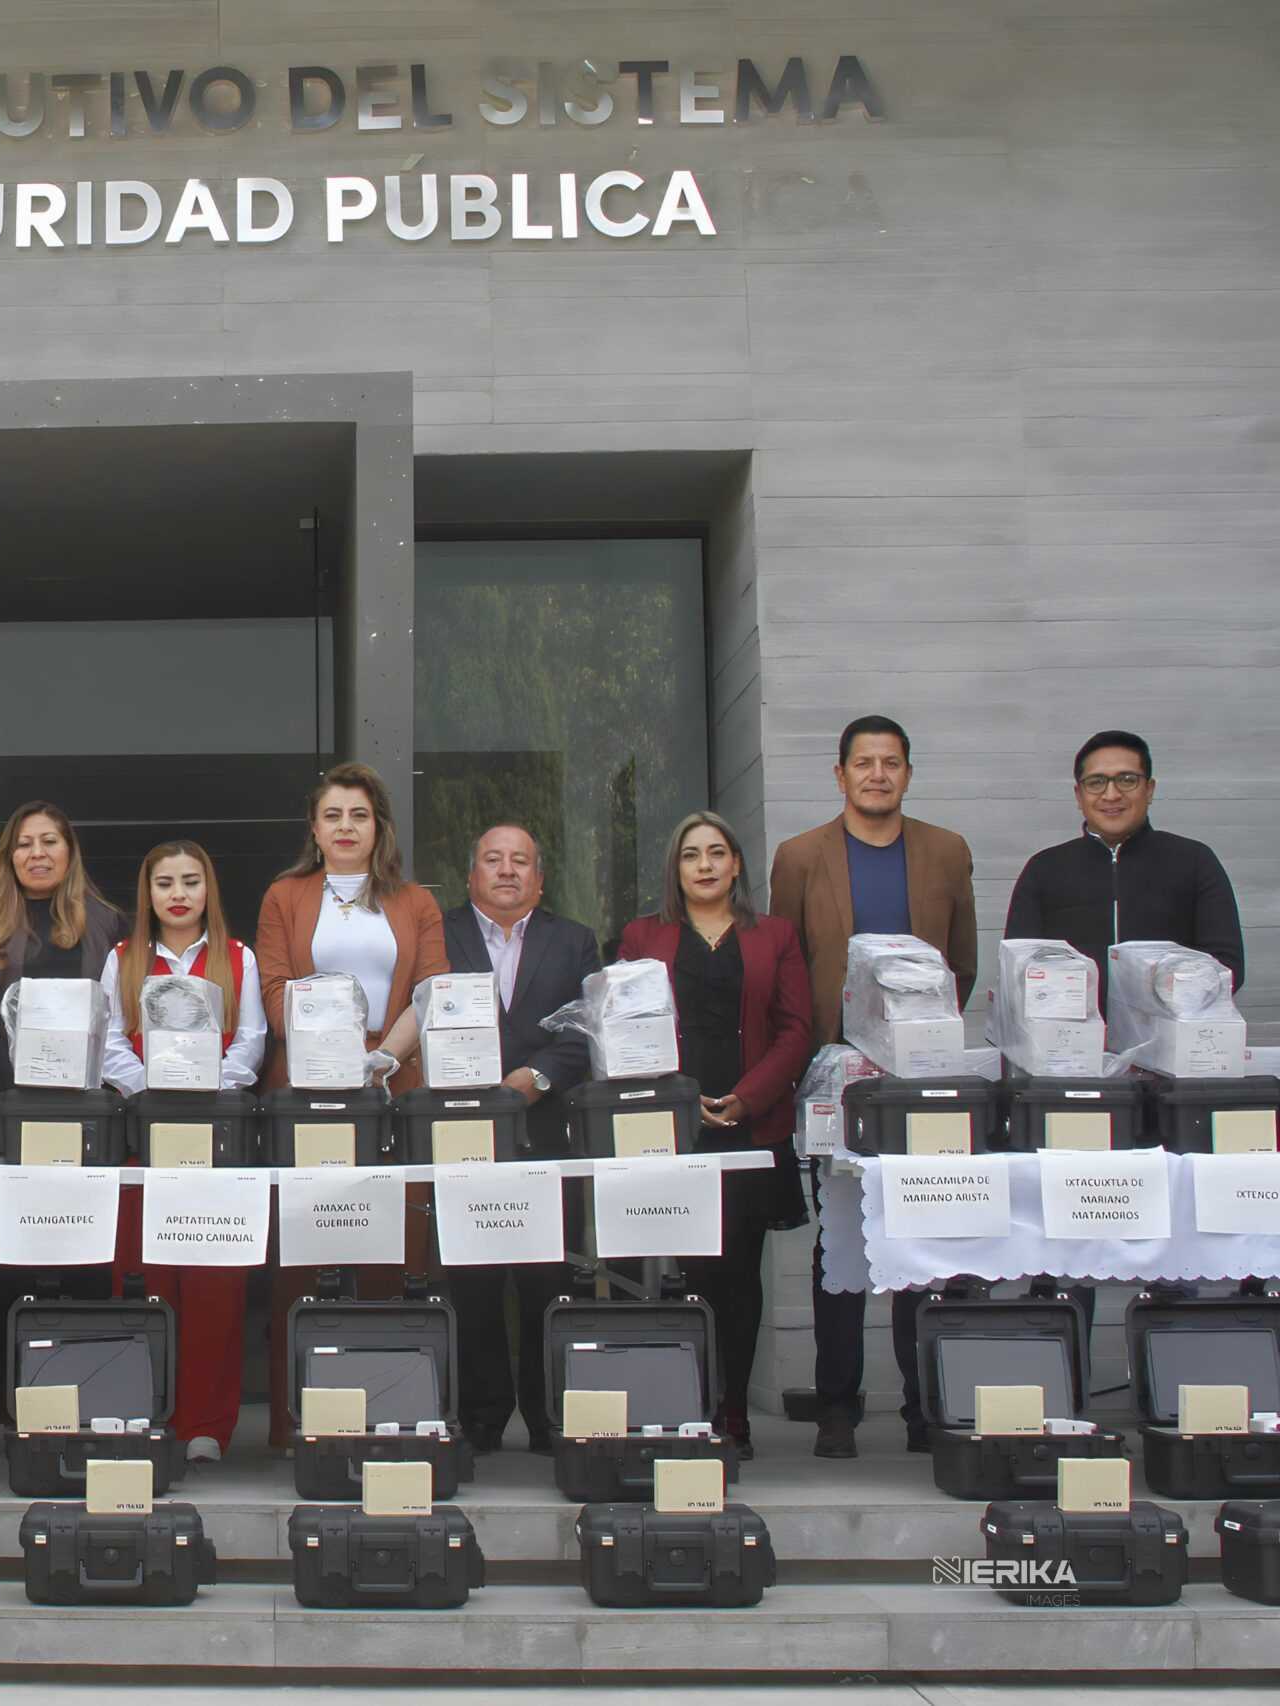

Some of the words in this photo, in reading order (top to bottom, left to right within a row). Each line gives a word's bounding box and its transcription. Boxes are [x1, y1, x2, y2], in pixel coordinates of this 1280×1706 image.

[289, 64, 453, 130] DEL
[479, 56, 882, 126] SISTEMA
[326, 153, 716, 243] PÚBLICA
[900, 1175, 975, 1186] NANACAMILPA
[976, 1175, 990, 1185] DE
[1065, 1178, 1129, 1188] IXTACUIXTLA
[1130, 1178, 1145, 1188] DE
[903, 1191, 953, 1203] MARIANO
[955, 1192, 991, 1202] ARISTA
[1080, 1194, 1130, 1205] MARIANO
[1236, 1190, 1279, 1200] IXTENCO
[312, 1202, 358, 1213] AMAXAC
[358, 1202, 372, 1212] DE
[467, 1202, 502, 1213] SANTA
[503, 1201, 529, 1212] CRUZ
[626, 1206, 690, 1216] HUAMANTLA
[19, 1215, 94, 1225] ATLANGATEPEC
[232, 1216, 248, 1226] DE
[1071, 1210, 1140, 1221] MATAMOROS
[315, 1217, 369, 1228] GUERRERO
[474, 1218, 525, 1230] TLAXCALA
[156, 1232, 204, 1243] ANTONIO
[205, 1232, 254, 1243] CARBAJAL
